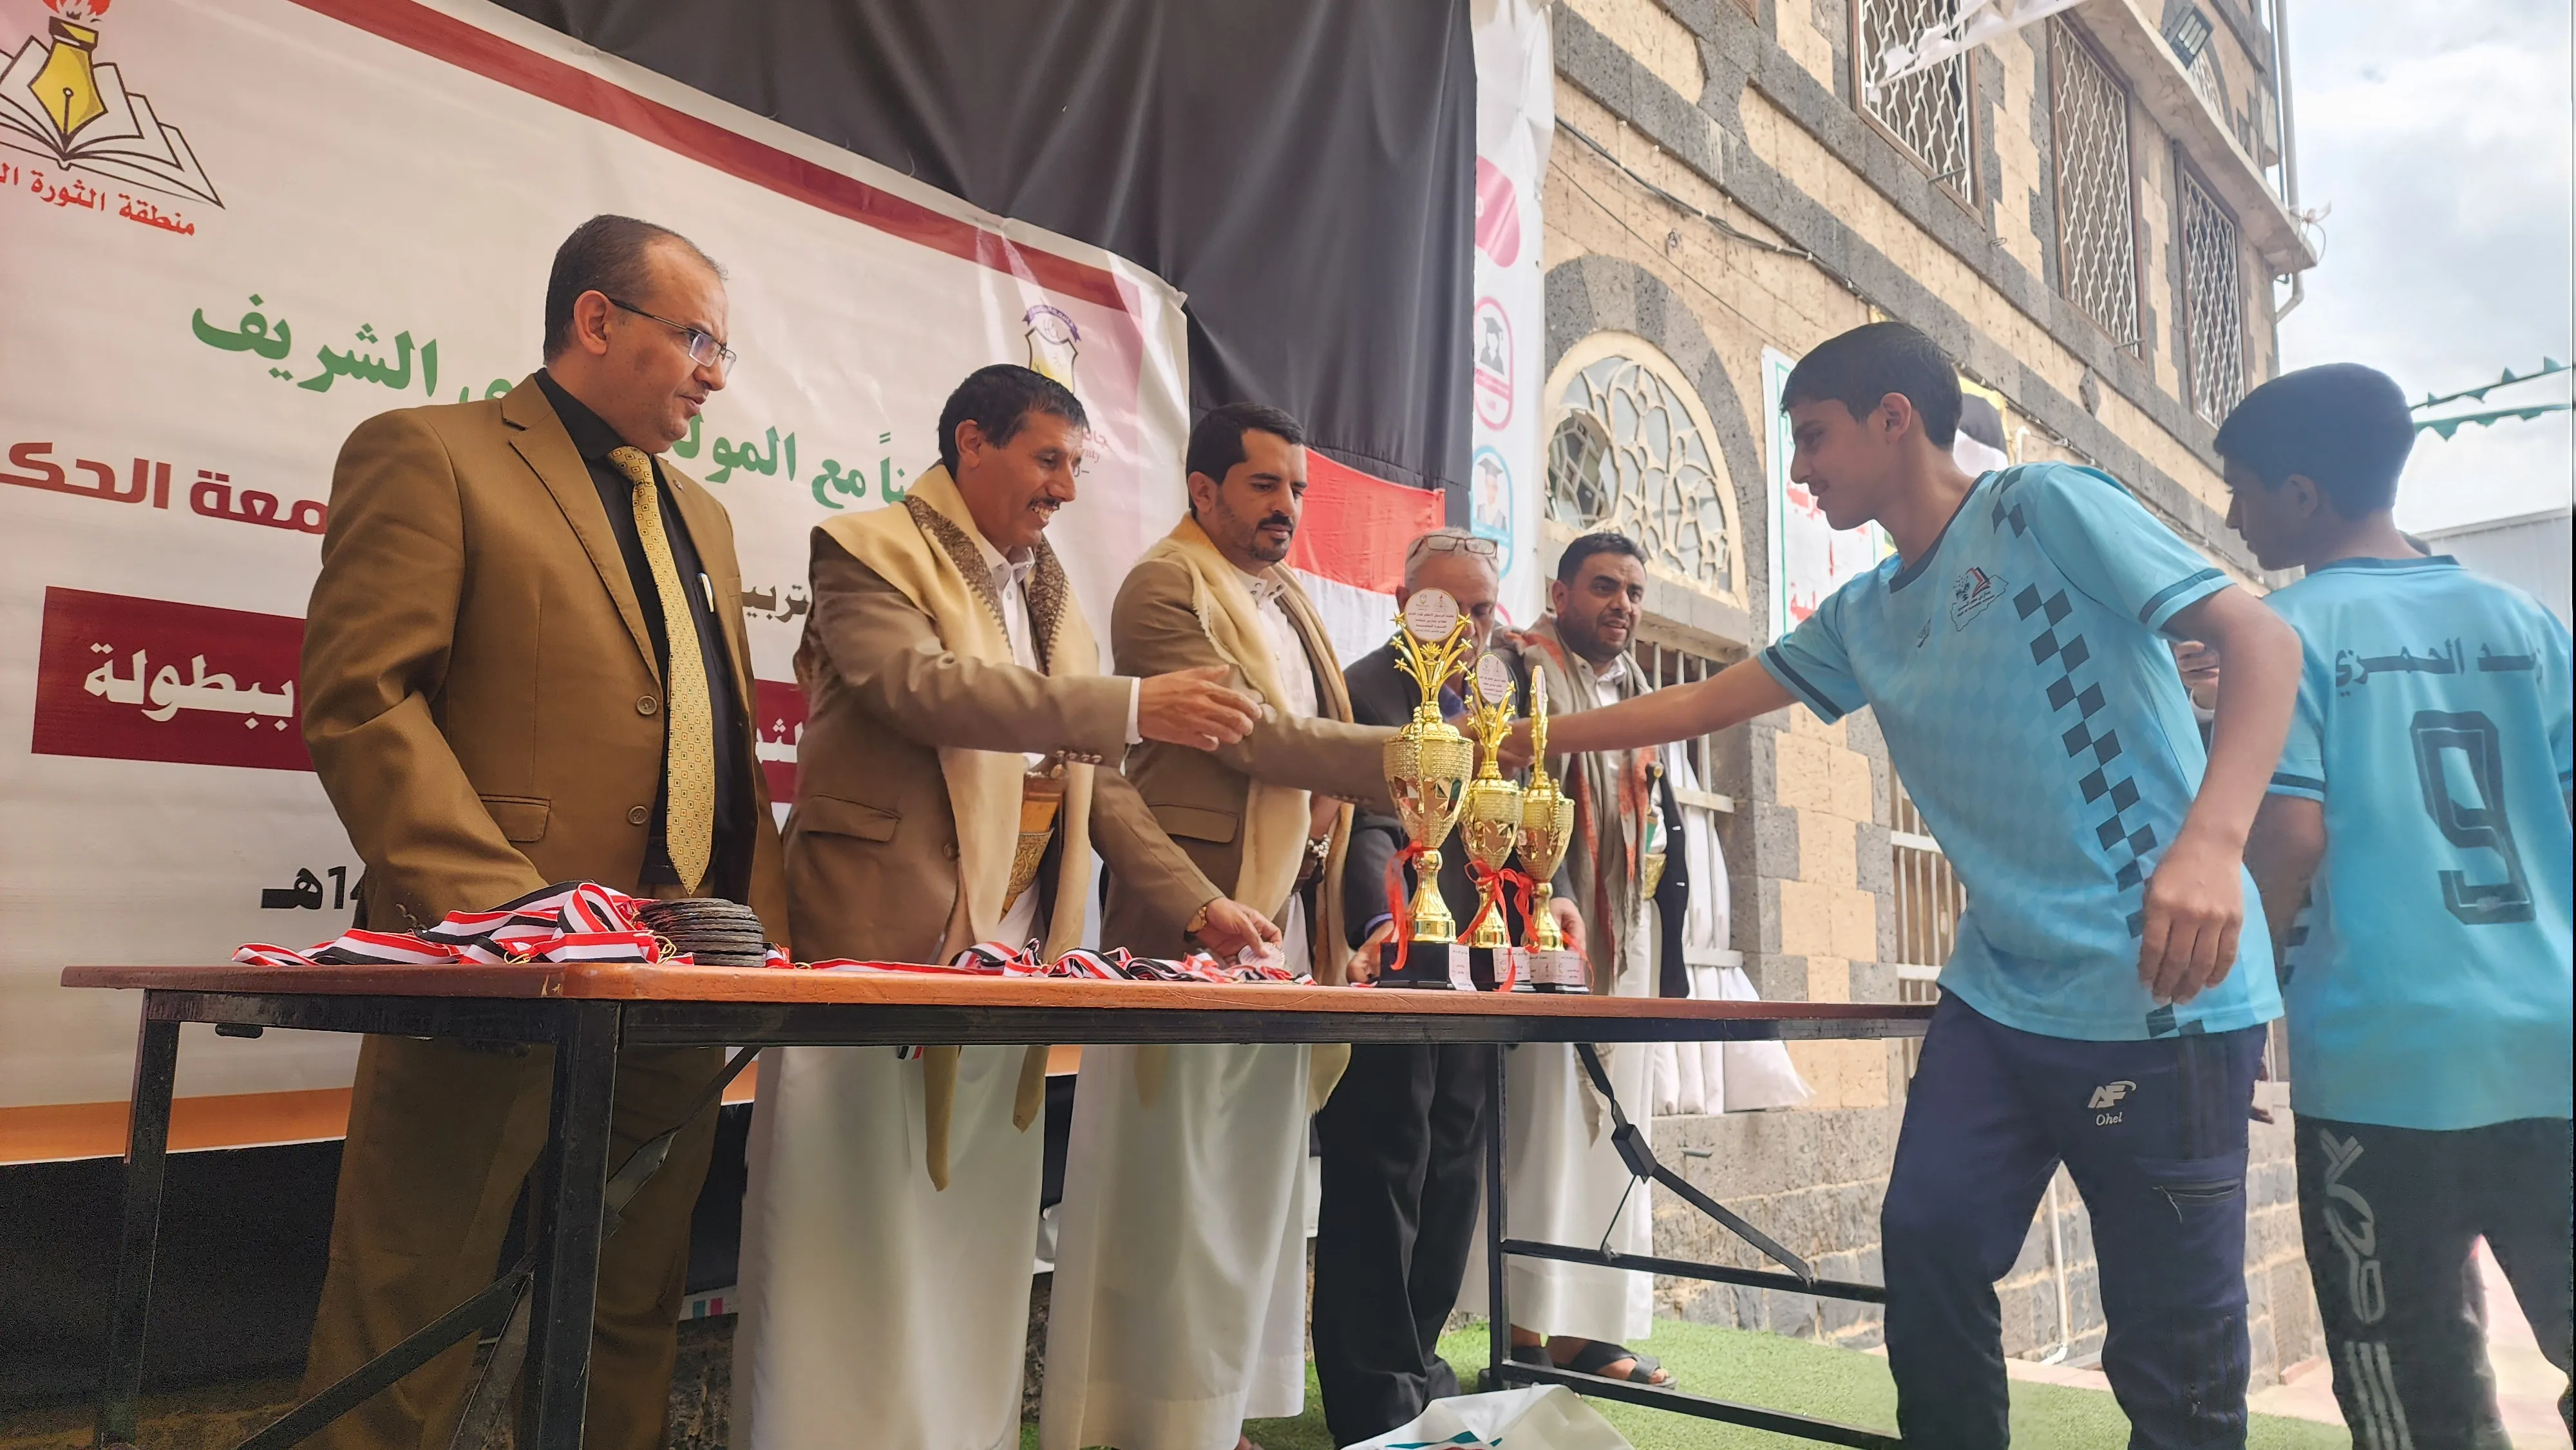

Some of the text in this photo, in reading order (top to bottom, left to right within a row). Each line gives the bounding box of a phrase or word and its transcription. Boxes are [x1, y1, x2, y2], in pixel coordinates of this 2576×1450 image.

[31, 169, 106, 211] الثورة
[118, 193, 194, 236] منطقة
[192, 294, 438, 397] الشريف
[672, 412, 797, 484] المول
[811, 459, 866, 509] مع
[0, 442, 328, 535] معة الحك
[742, 583, 810, 623] تربي
[84, 643, 295, 731] ببطولة
[2409, 710, 2536, 925] 9
